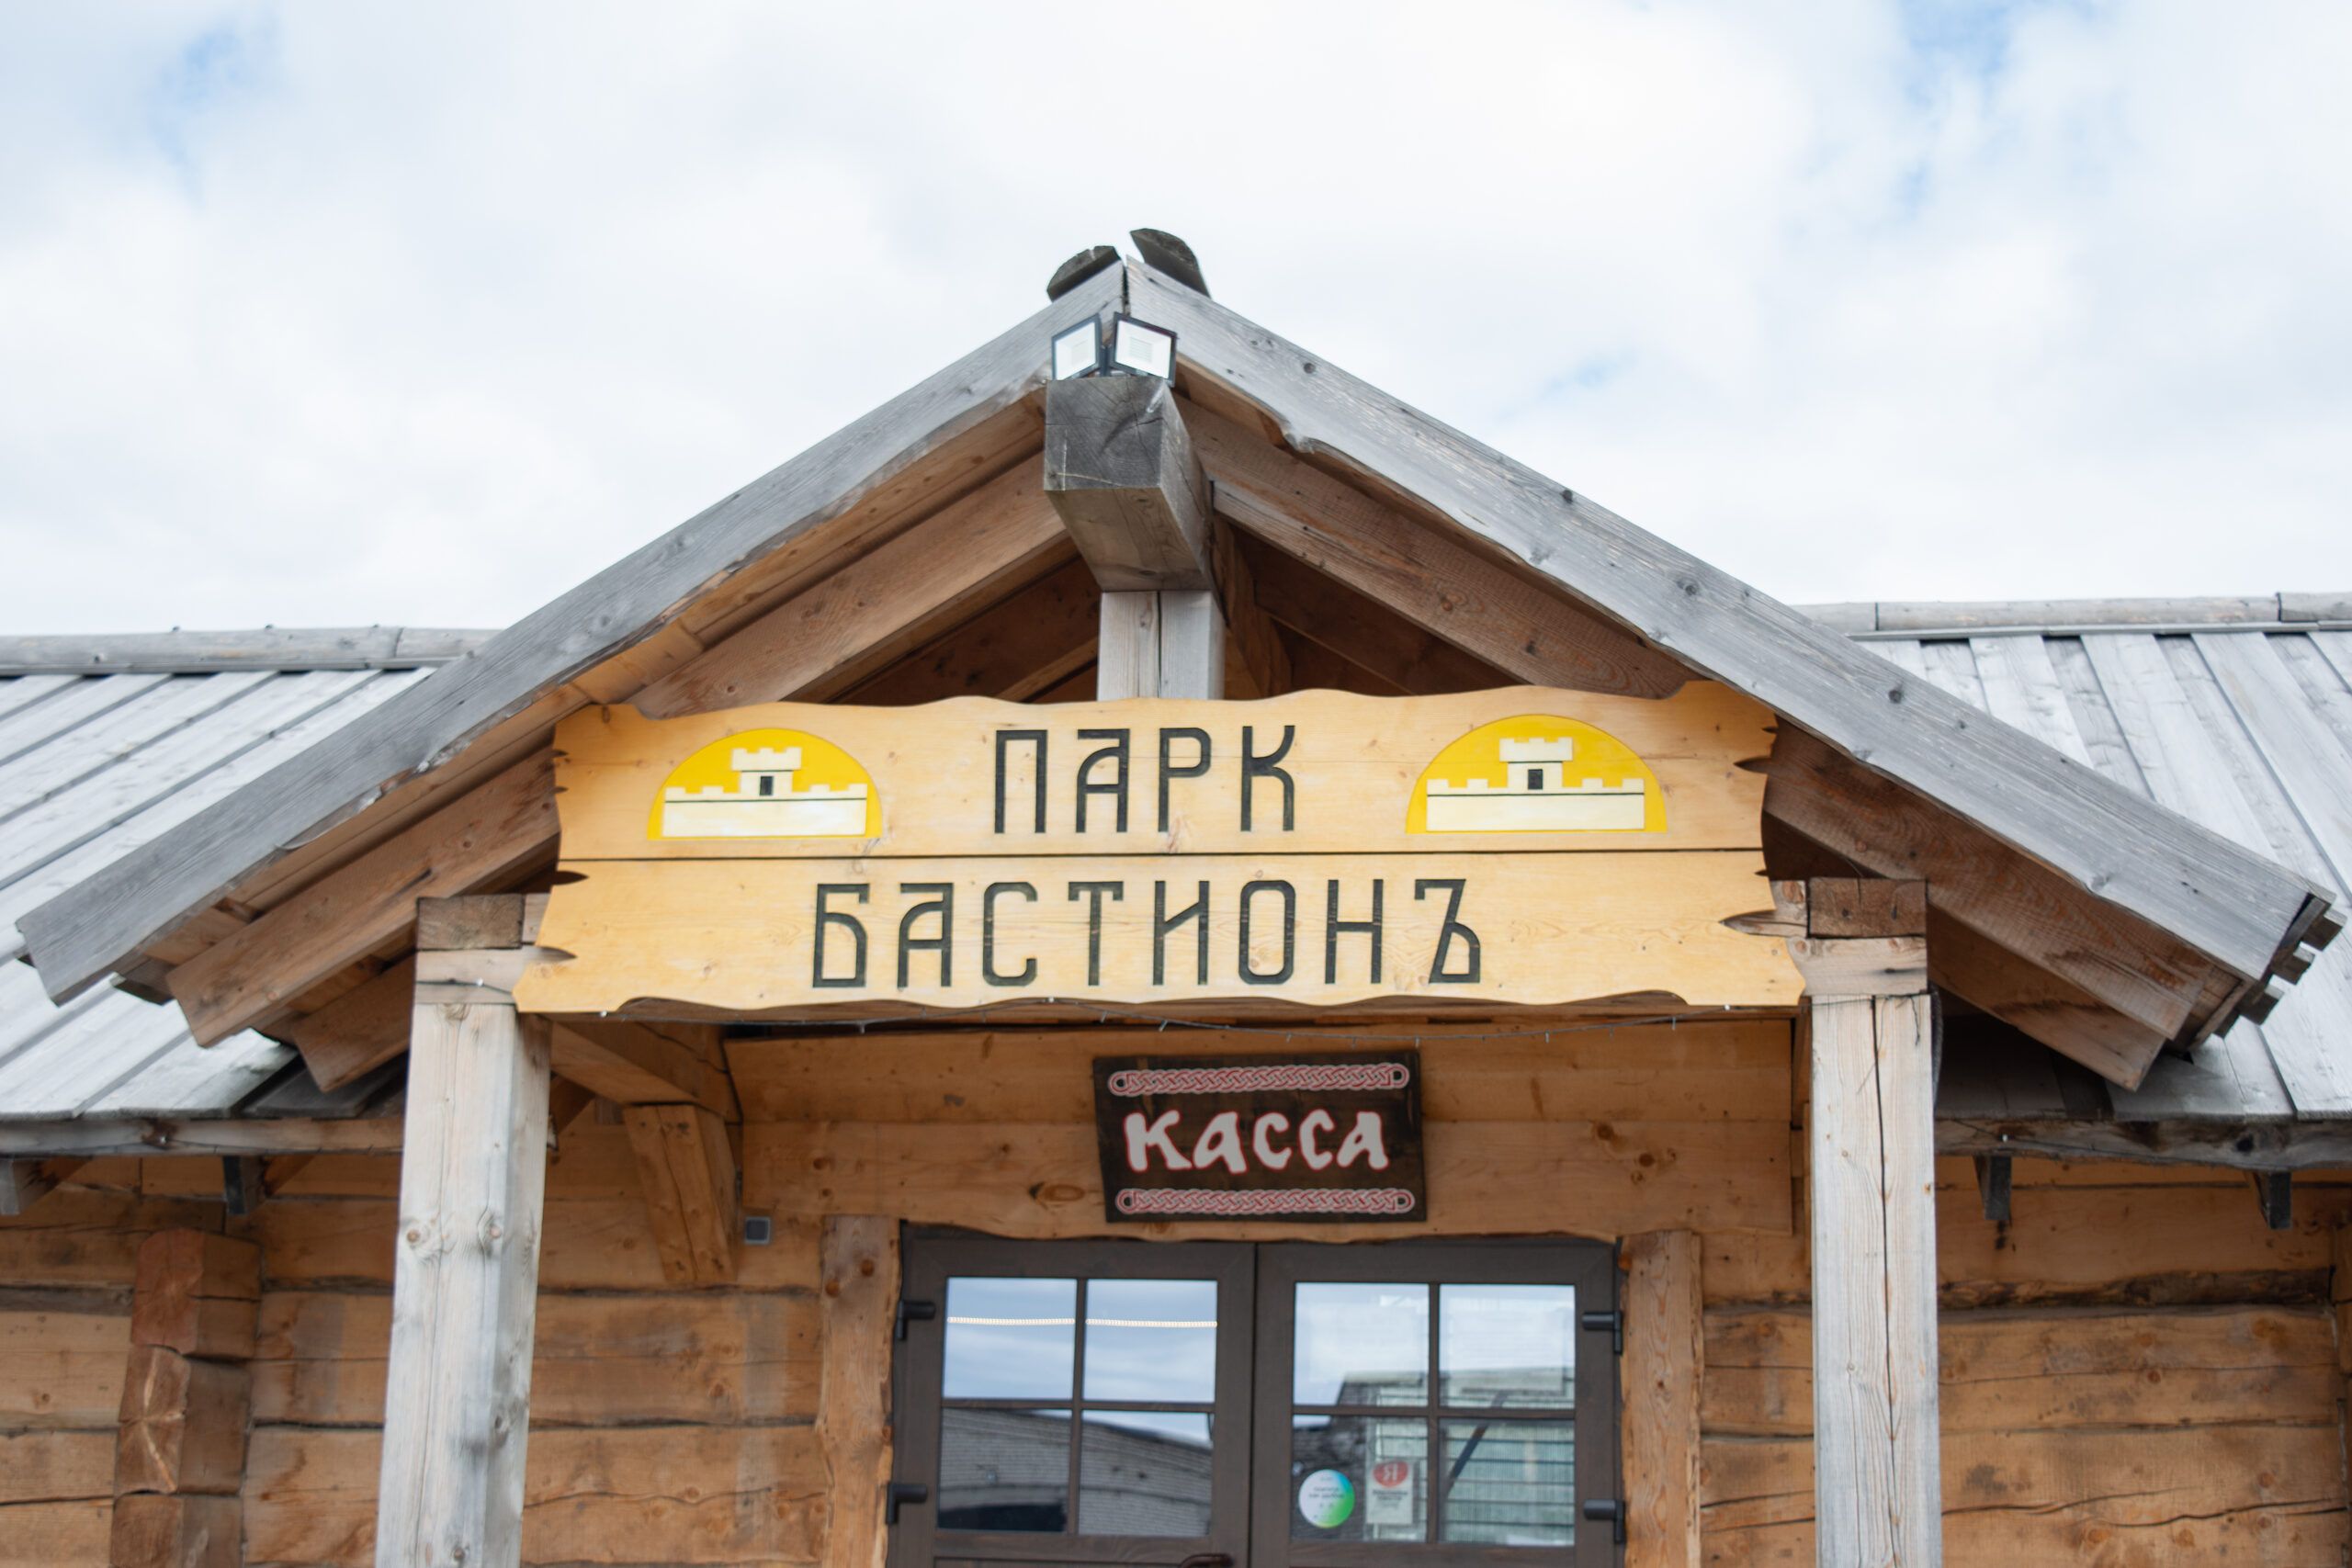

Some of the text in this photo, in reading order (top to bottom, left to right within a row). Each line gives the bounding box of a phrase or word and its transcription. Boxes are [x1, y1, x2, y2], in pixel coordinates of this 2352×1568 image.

[994, 725, 1296, 833] ПАРК
[812, 879, 1481, 988] БАСТИОНЪ
[1123, 1109, 1389, 1174] КАССА
